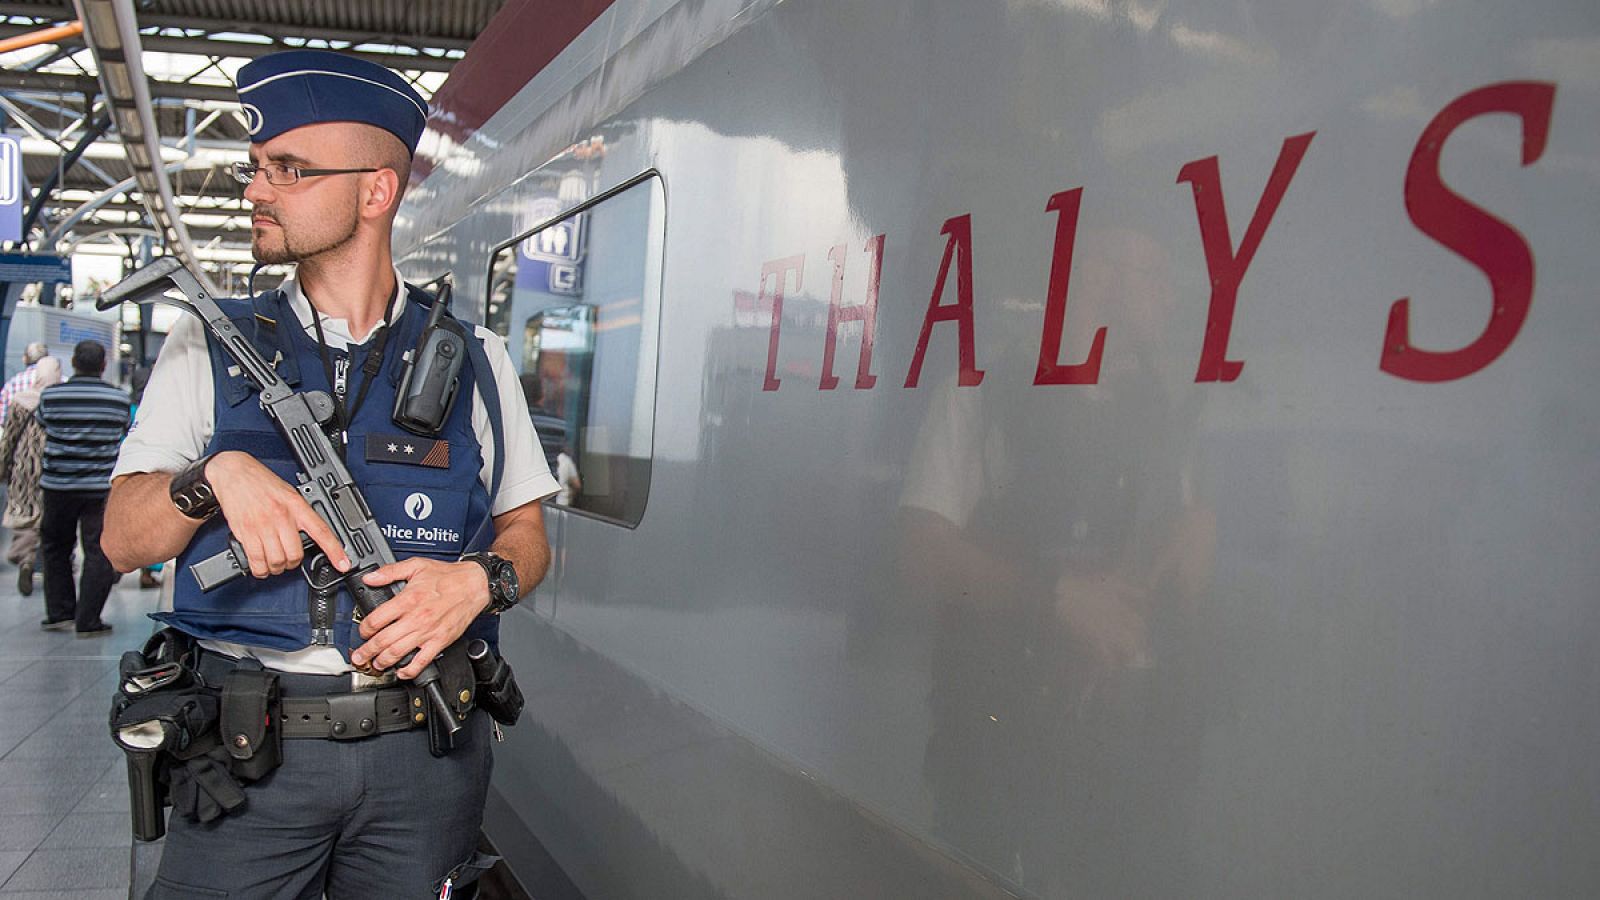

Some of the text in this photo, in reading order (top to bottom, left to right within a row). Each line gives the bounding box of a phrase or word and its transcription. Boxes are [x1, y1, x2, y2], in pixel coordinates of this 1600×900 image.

[758, 80, 1556, 391] THALYS
[381, 525, 459, 542] lice Politie
